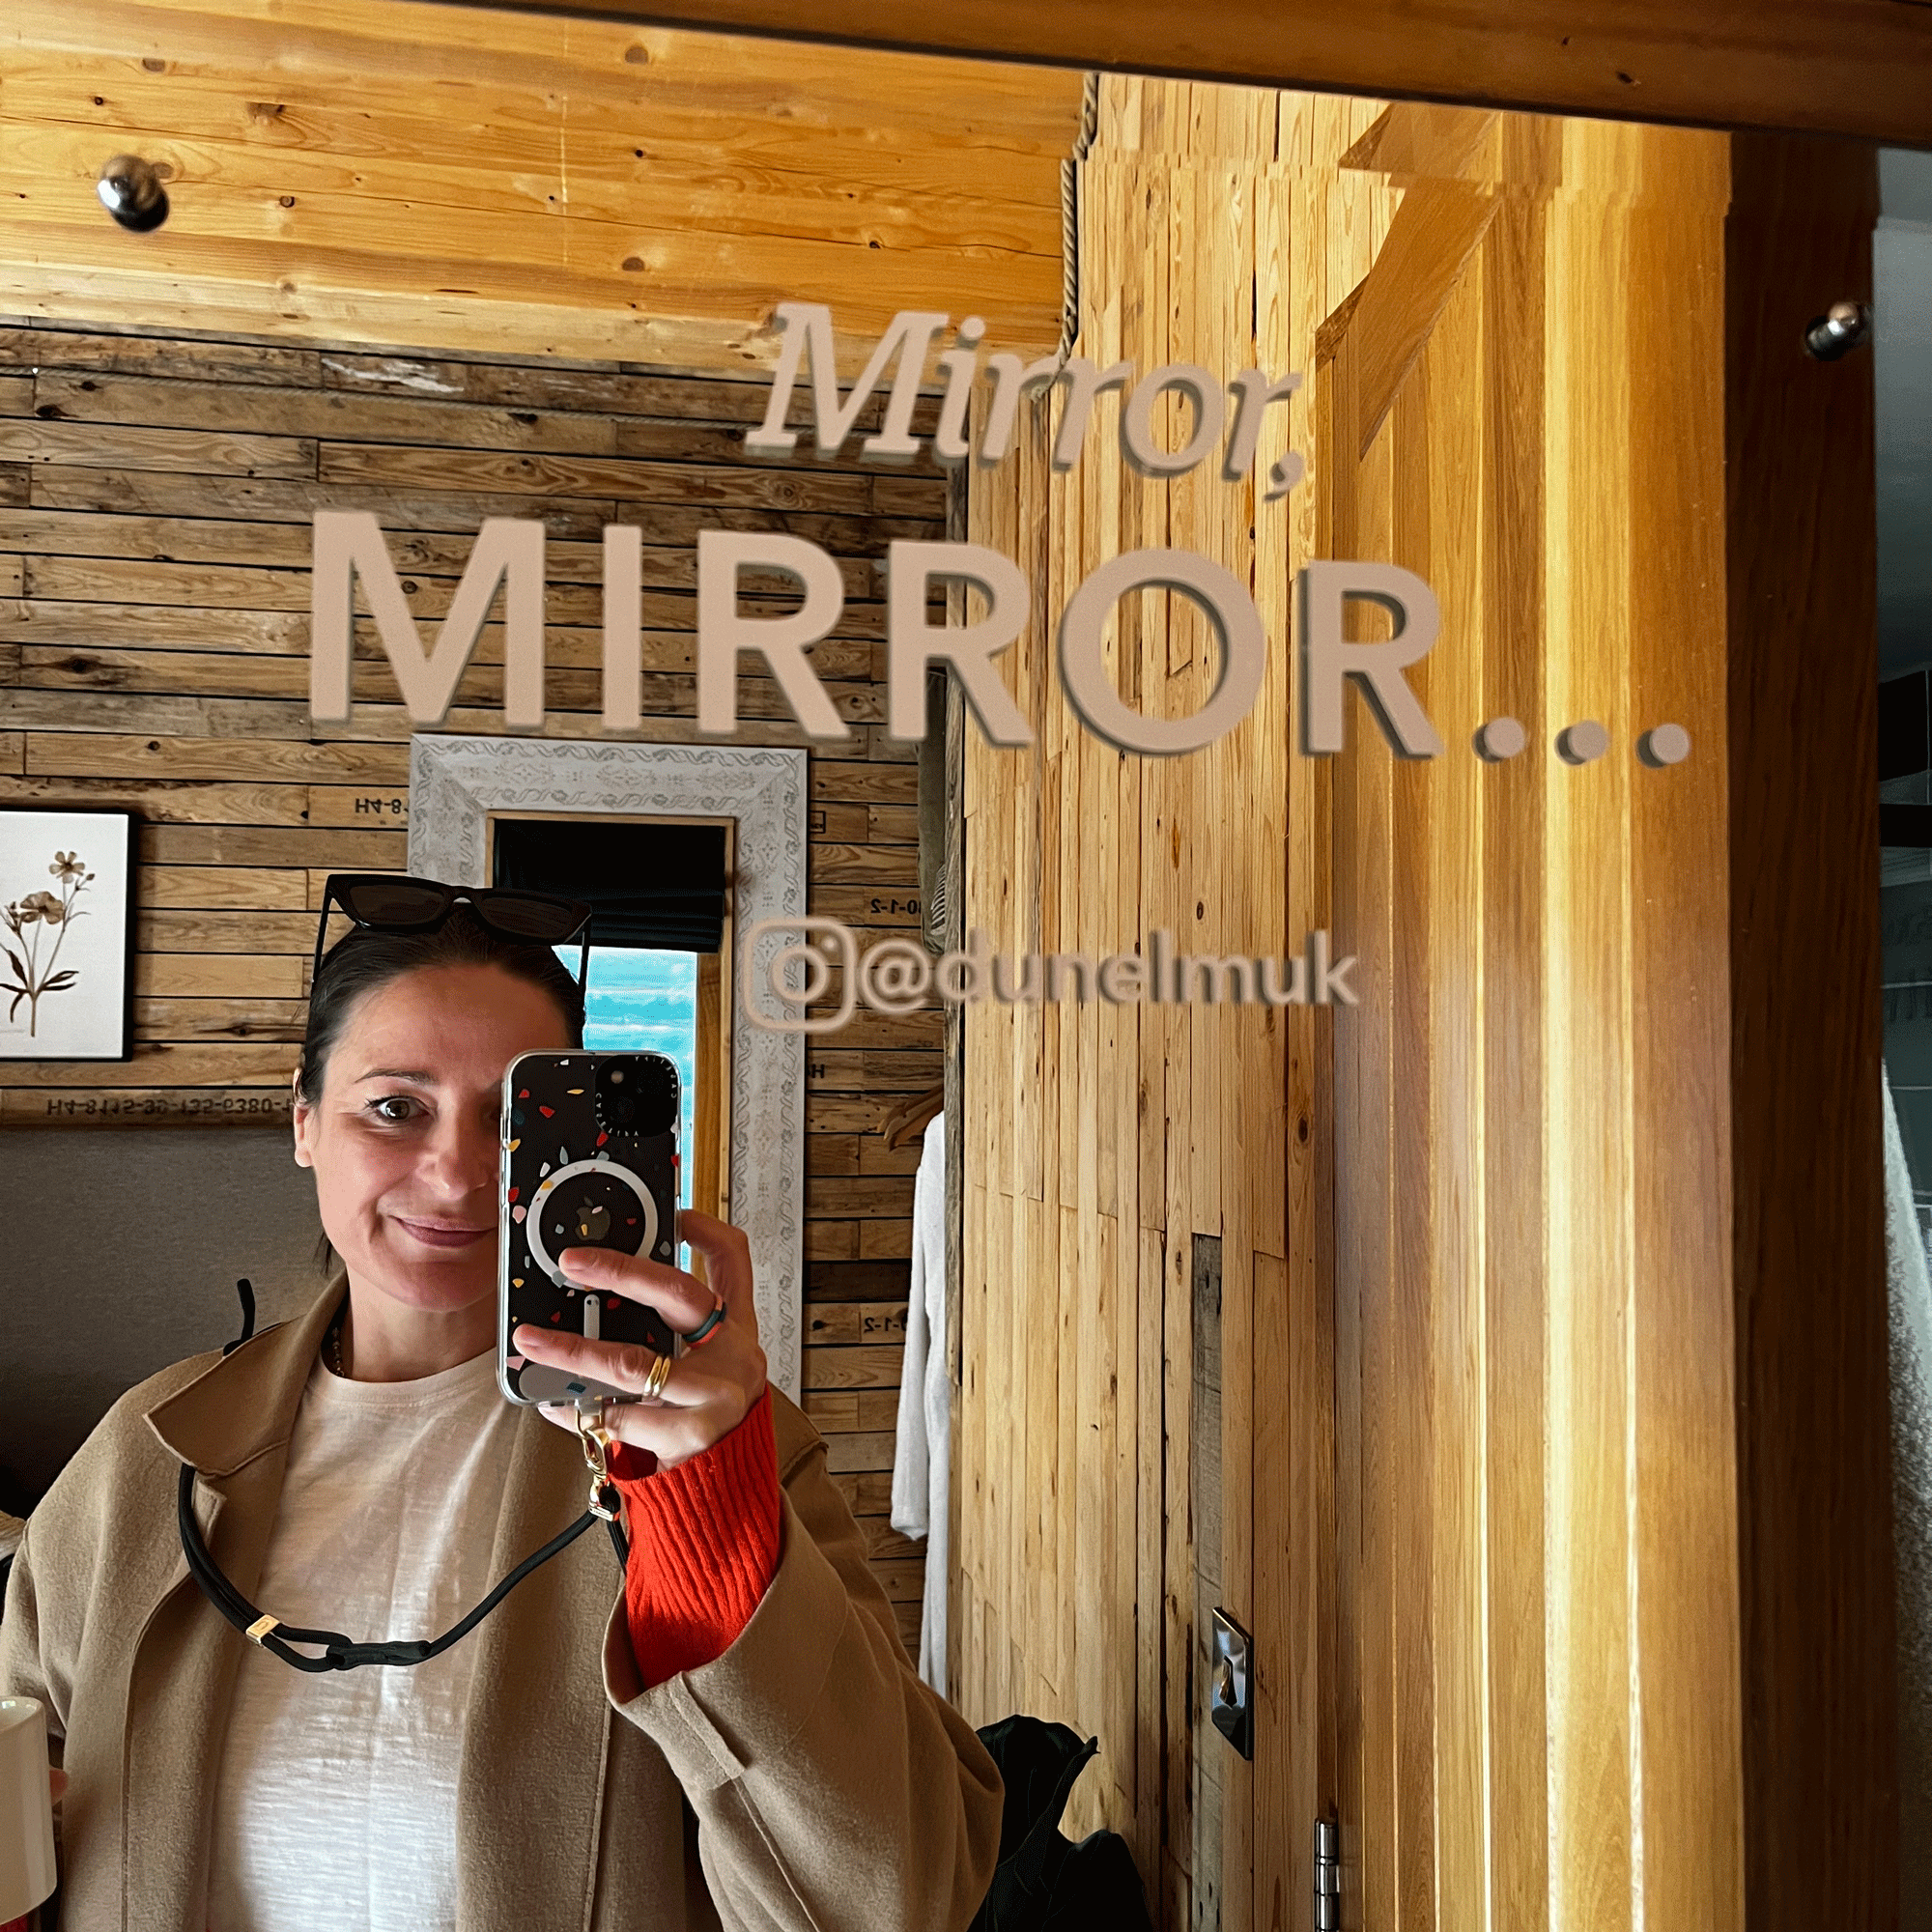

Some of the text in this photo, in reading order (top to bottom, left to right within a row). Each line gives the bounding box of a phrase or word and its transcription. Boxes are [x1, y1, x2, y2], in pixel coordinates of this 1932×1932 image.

[743, 301, 1303, 500] Mirror,
[309, 510, 1690, 763] MIRROR...
[859, 927, 1359, 1013] @dunelmuk
